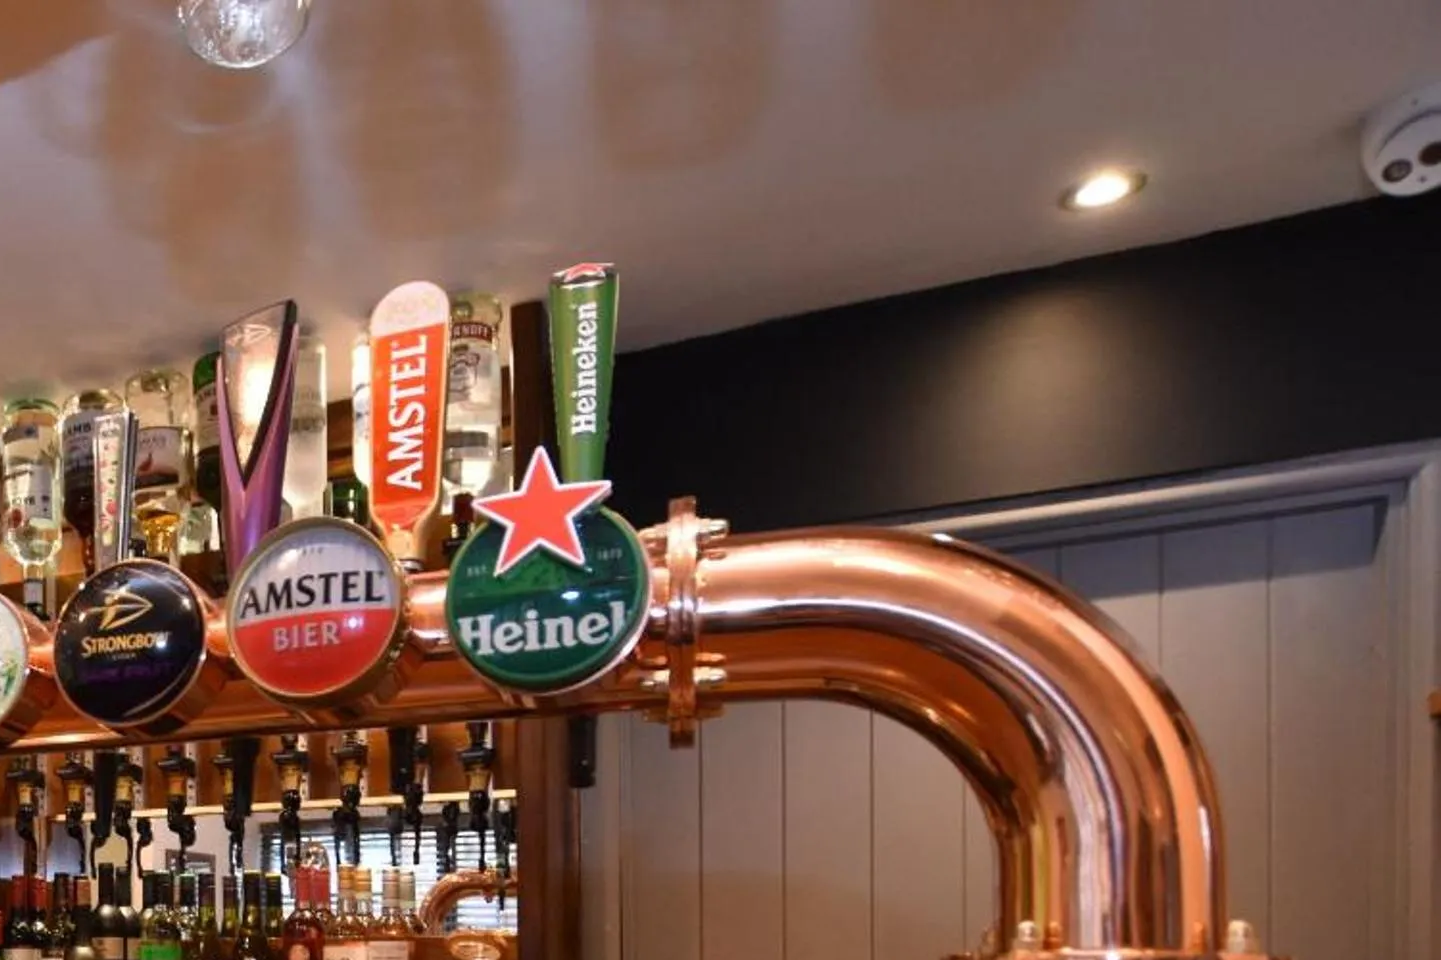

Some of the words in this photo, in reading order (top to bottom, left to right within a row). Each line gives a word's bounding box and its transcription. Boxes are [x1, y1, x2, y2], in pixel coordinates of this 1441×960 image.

[387, 334, 428, 491] AMSTEL
[571, 301, 598, 436] Heineken
[240, 570, 386, 619] AMSTEL
[273, 619, 340, 652] BIER
